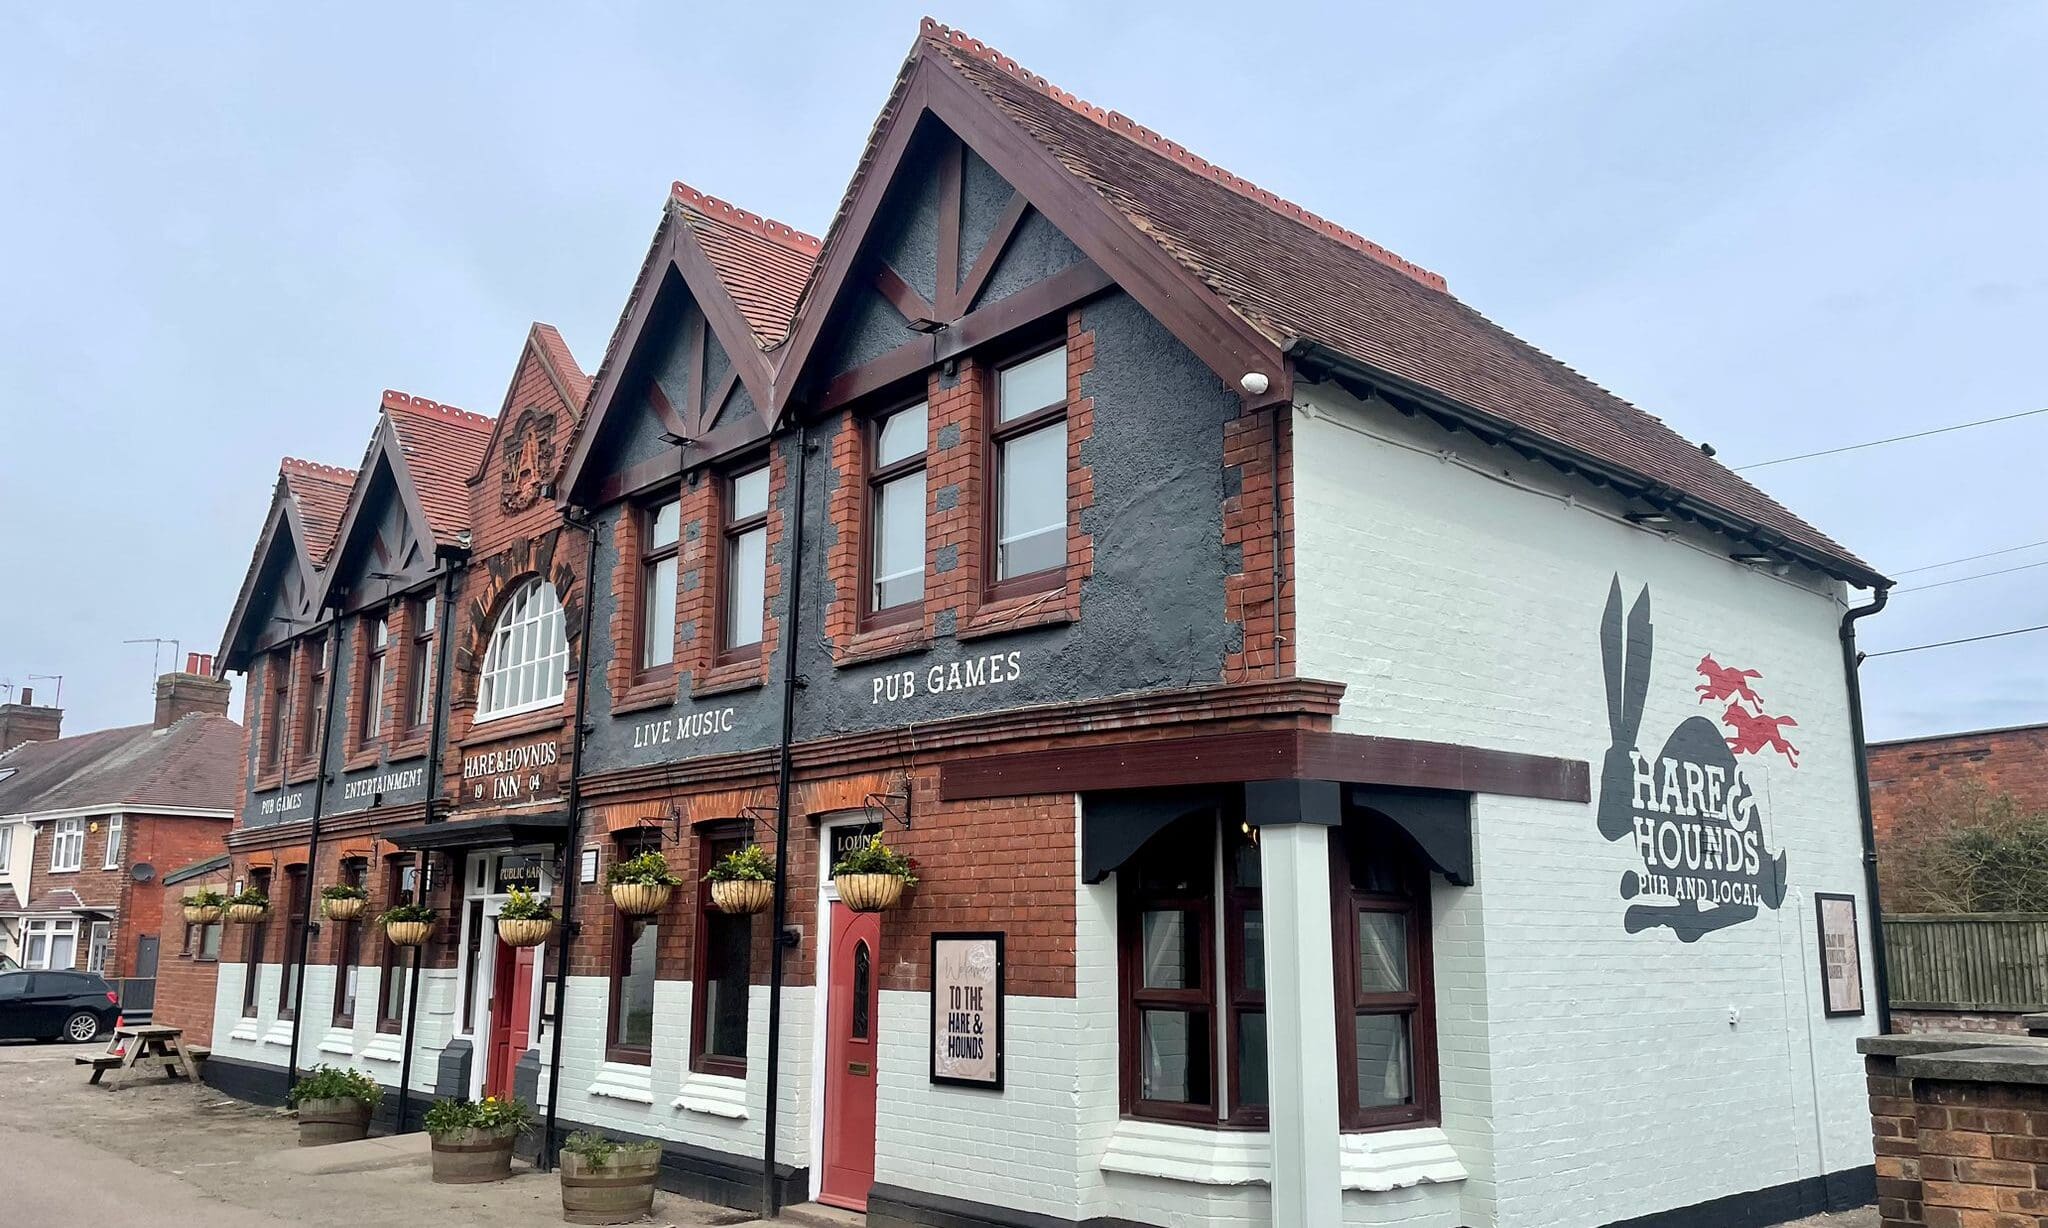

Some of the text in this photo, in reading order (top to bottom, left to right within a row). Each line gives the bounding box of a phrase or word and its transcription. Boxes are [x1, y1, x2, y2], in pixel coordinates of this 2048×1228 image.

[872, 651, 1021, 704] PUB GAMES
[633, 707, 734, 749] LIVE MUSIC
[344, 768, 423, 800] ENTERTAINMENT
[474, 773, 541, 800] 19 INN 04
[261, 793, 303, 815] PUB GAMES
[838, 834, 872, 852] LOUN
[1633, 816, 1760, 876] HOUNDS
[500, 867, 525, 881] PUBLIC
[1675, 876, 1708, 901] AND
[1711, 879, 1762, 906] LOCAL
[949, 986, 983, 1011] TO THE
[948, 1012, 984, 1035] HARE &
[948, 1035, 984, 1060] HOUNDS
